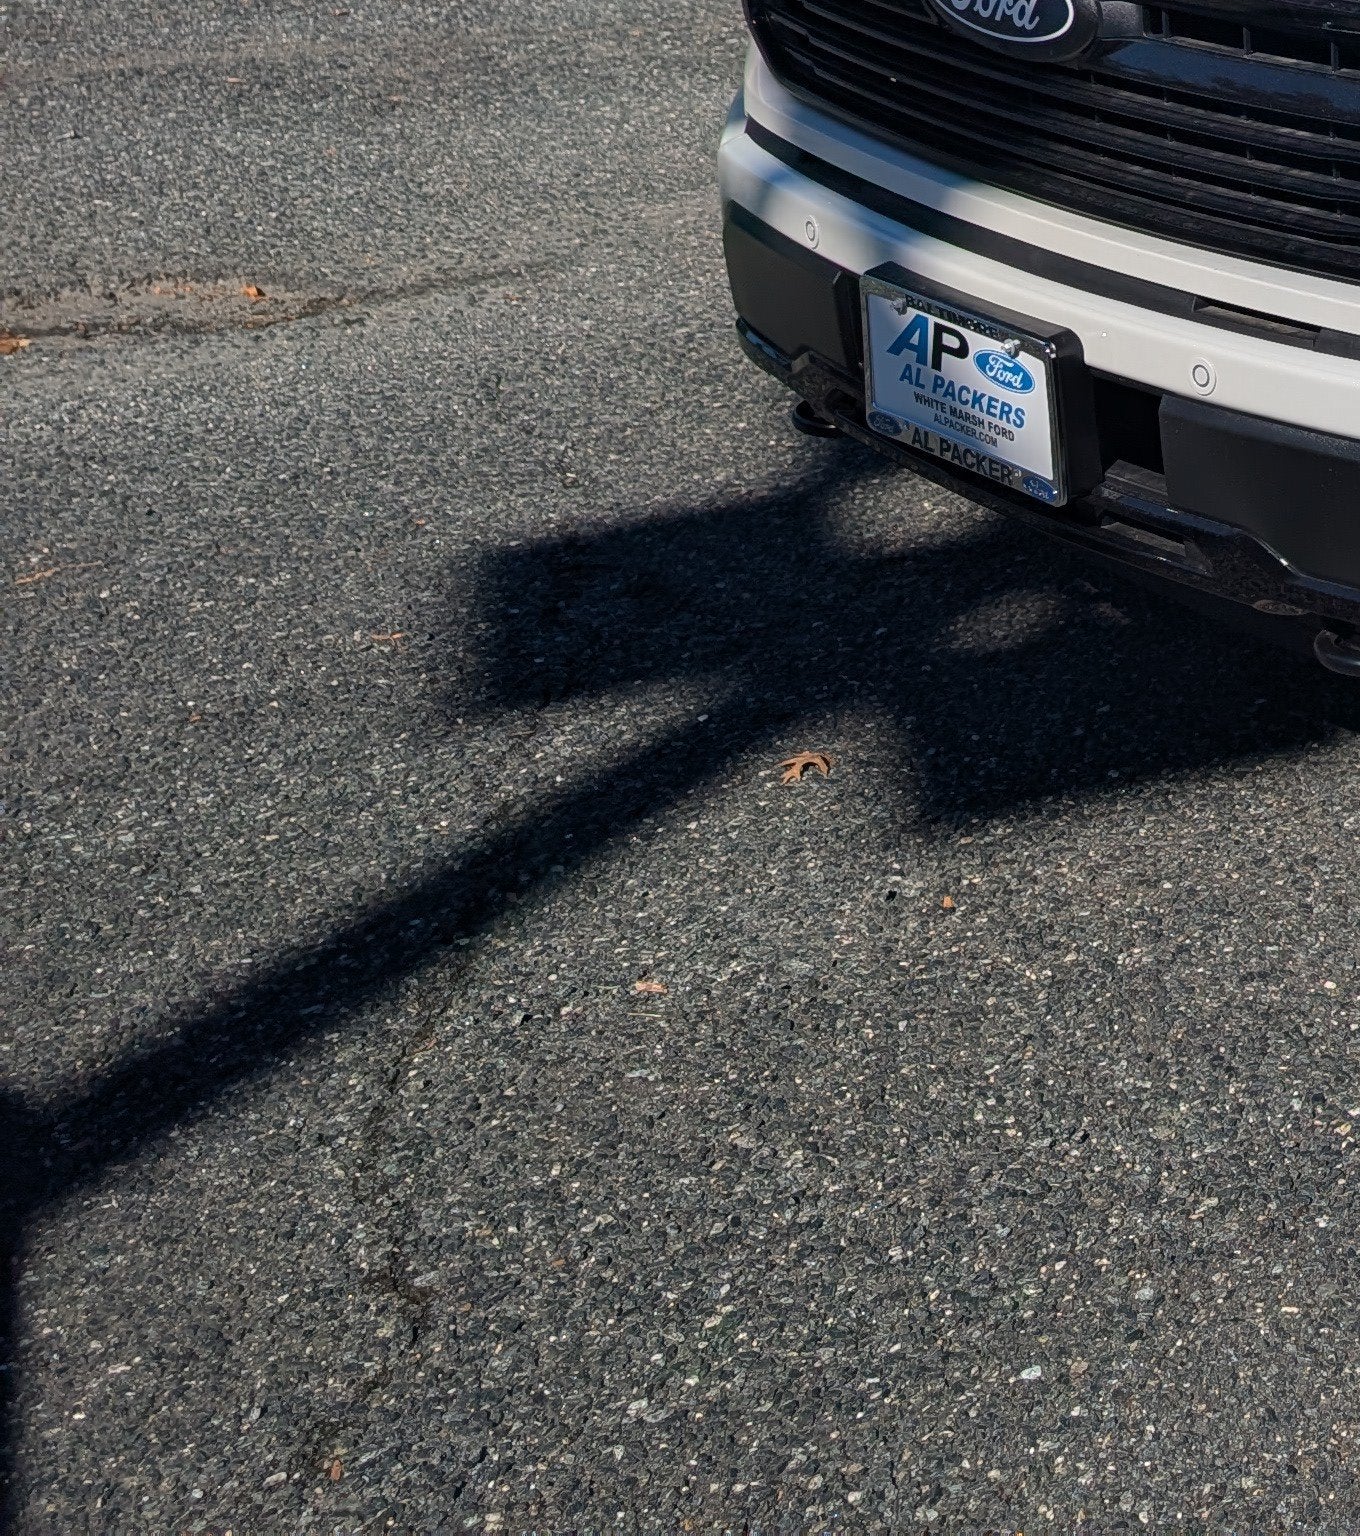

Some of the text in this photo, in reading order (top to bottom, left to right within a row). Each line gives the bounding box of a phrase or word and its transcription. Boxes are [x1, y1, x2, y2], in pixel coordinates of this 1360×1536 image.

[887, 314, 970, 372] AP
[899, 364, 1026, 429] AL PACKERS
[985, 353, 1024, 389] Ford
[914, 391, 1015, 442] WHITE MARSH FORD
[933, 413, 998, 447] ALPACKER.COM
[911, 427, 1014, 486] AL PACKER
